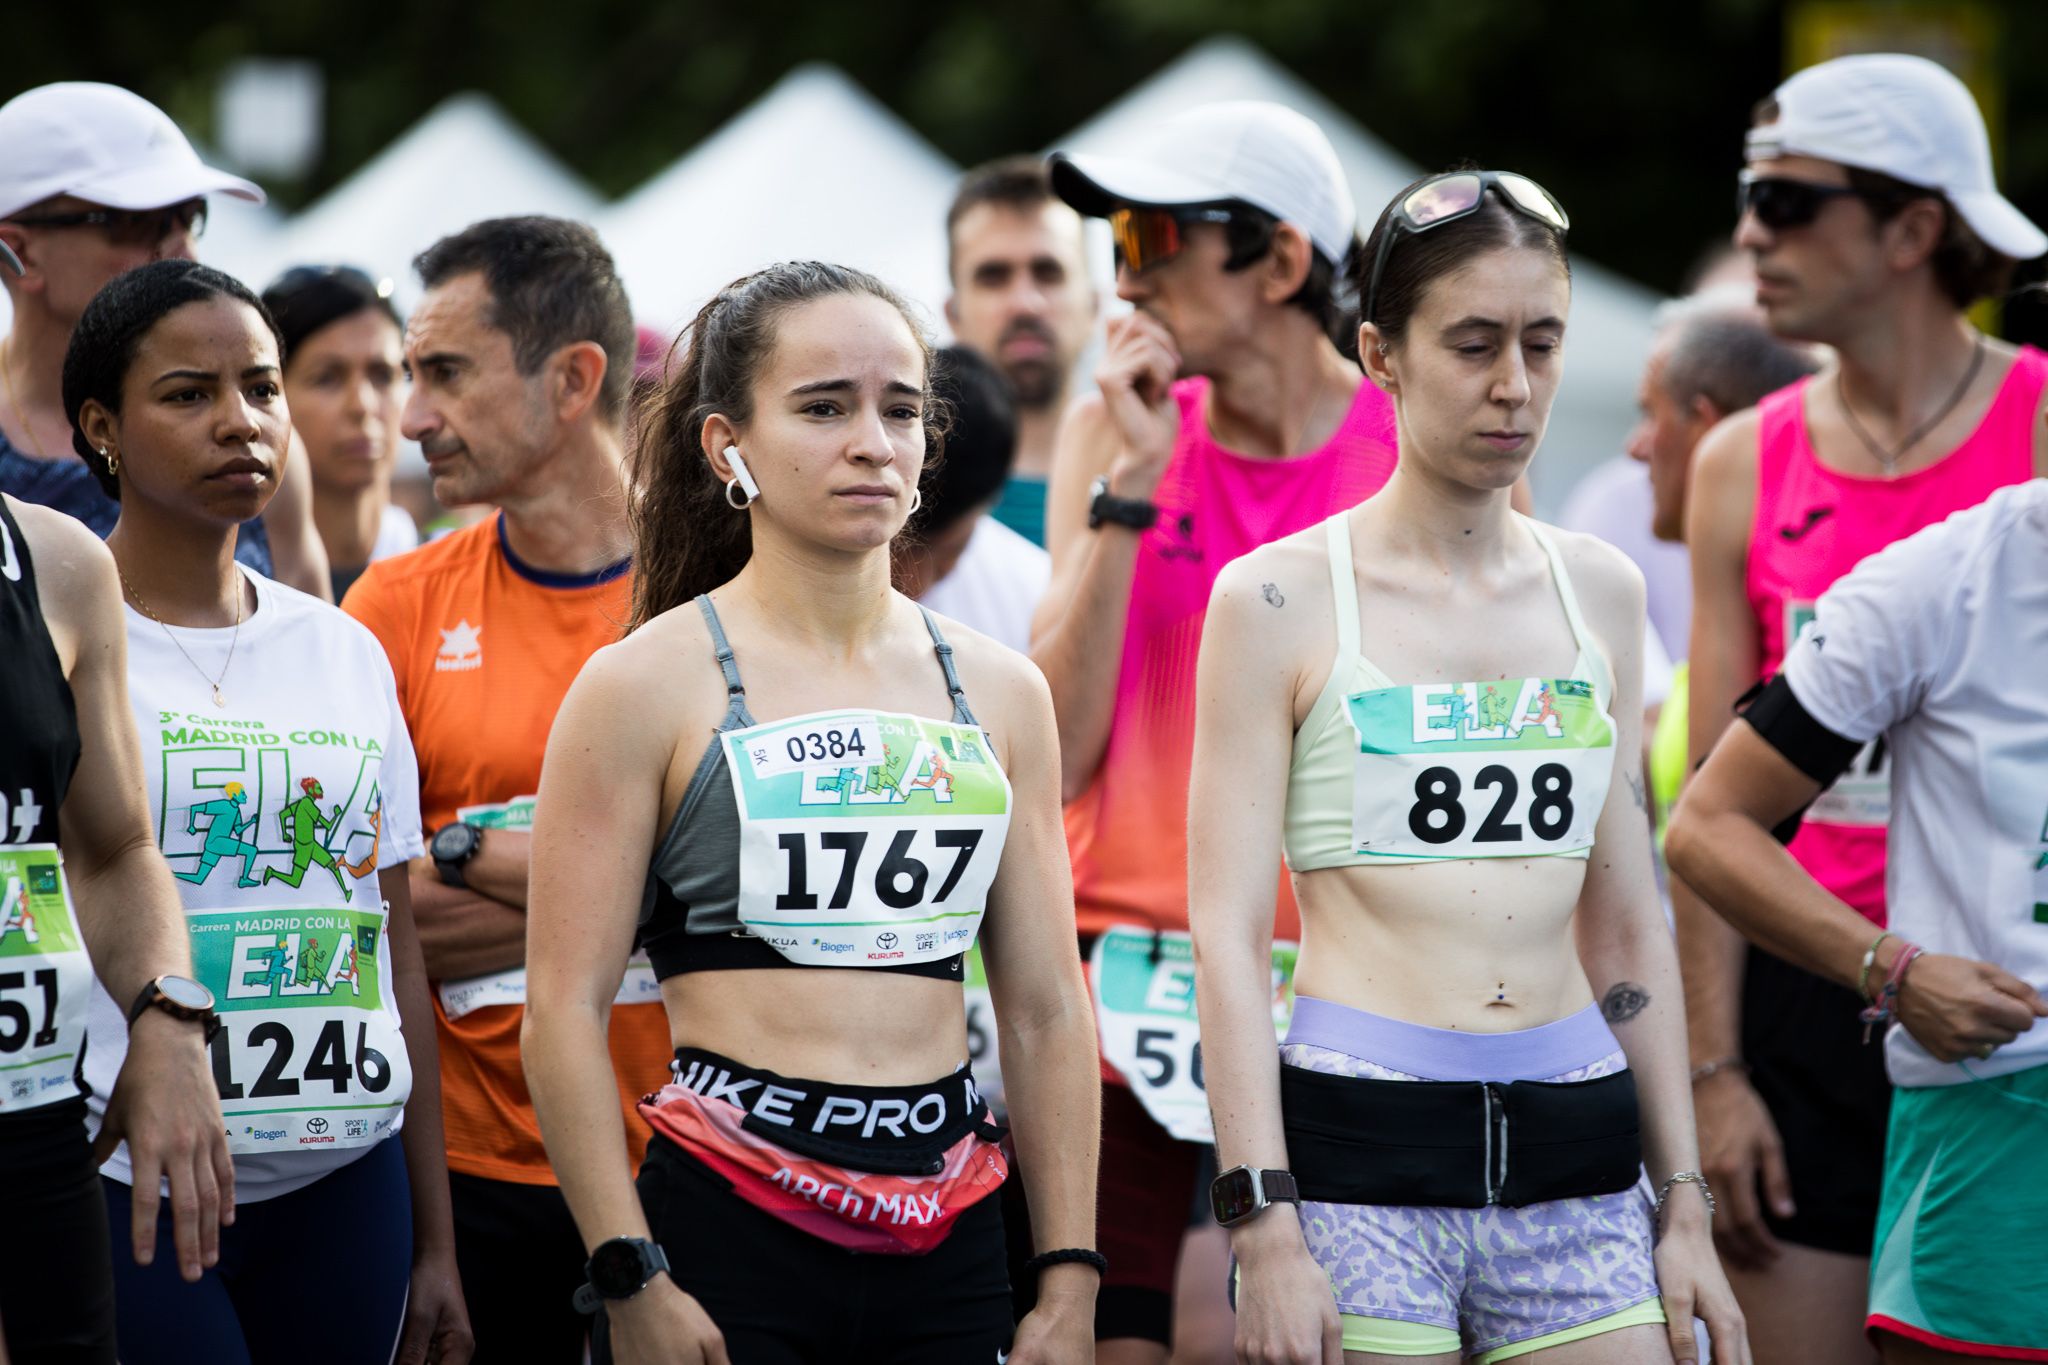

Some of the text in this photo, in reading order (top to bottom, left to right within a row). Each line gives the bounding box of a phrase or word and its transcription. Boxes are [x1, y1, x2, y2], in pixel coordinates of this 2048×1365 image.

[186, 713, 265, 729] Carrera
[1412, 677, 1563, 743] ELA
[161, 727, 382, 753] MADRID CON LA
[786, 727, 866, 762] 0384
[753, 748, 769, 766] 5K
[799, 740, 954, 806] ELA
[1408, 762, 1575, 844] 828
[775, 829, 984, 911] 1767
[190, 917, 350, 933] Carrera MADRID CON LA
[821, 942, 855, 954] Biogen
[917, 941, 934, 950] LIFE
[227, 932, 360, 999] ELA
[210, 1020, 391, 1100] 1246
[671, 1059, 807, 1127] NIKE
[811, 1093, 946, 1138] PRO
[254, 1129, 288, 1140] Biogen
[344, 1119, 364, 1127] SPORT
[347, 1127, 361, 1136] LIFE
[869, 1190, 943, 1225] MAX
